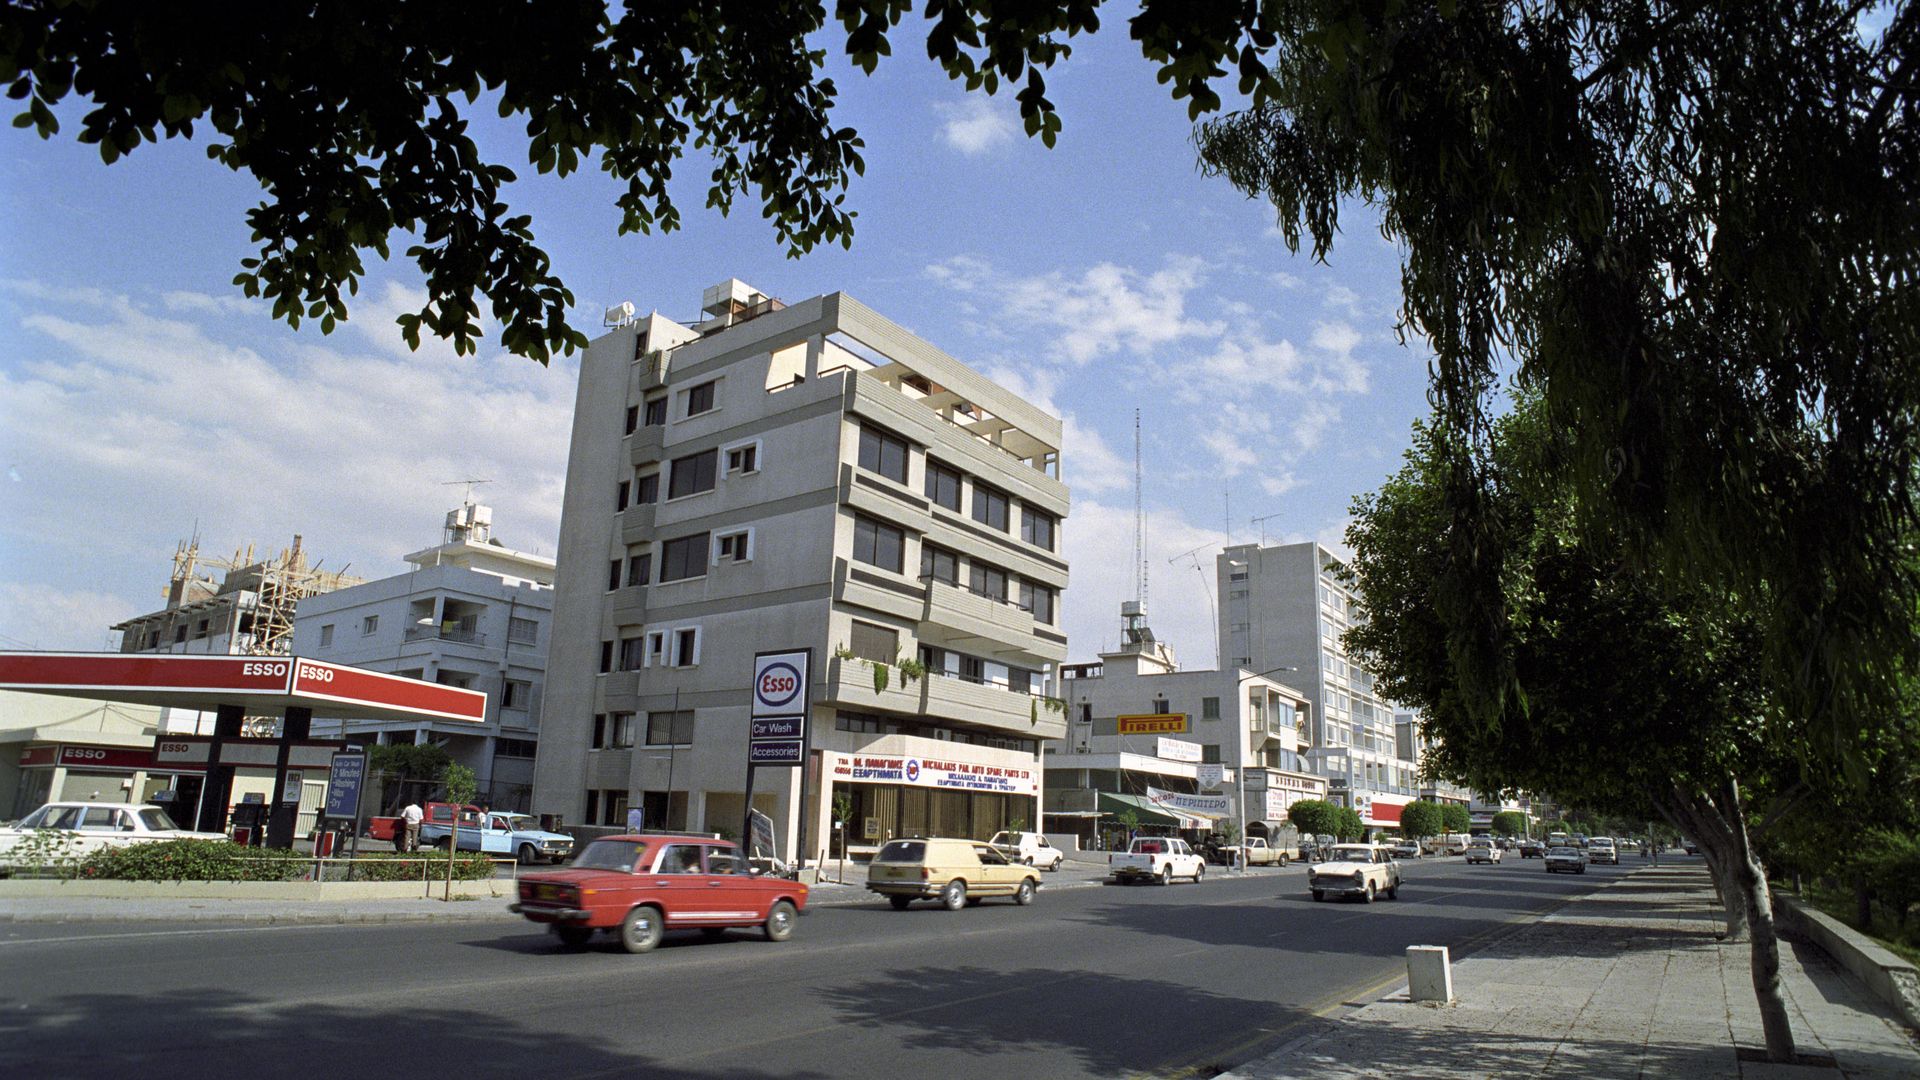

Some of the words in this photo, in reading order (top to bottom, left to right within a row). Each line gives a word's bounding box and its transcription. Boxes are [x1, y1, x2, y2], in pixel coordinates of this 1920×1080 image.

[243, 663, 286, 676] ESSO
[300, 665, 334, 682] ESSO
[762, 675, 794, 693] Esso
[753, 724, 766, 733] Car
[769, 723, 792, 732] Wash
[1121, 716, 1184, 731] PIRELLI
[162, 744, 189, 752] ESSO
[752, 746, 799, 756] Accessories
[65, 749, 106, 759] ESSO
[334, 769, 338, 777] 2
[853, 769, 902, 779] ΕΞΑΡΤΗΜΑΤΑ
[922, 760, 956, 771] MICHALAKIS
[972, 765, 984, 774] AUTO
[987, 767, 1002, 776] SPARE
[1004, 769, 1019, 778] PARTS
[1176, 797, 1226, 809] ΠΕΡΙΠΤΕΡΟ
